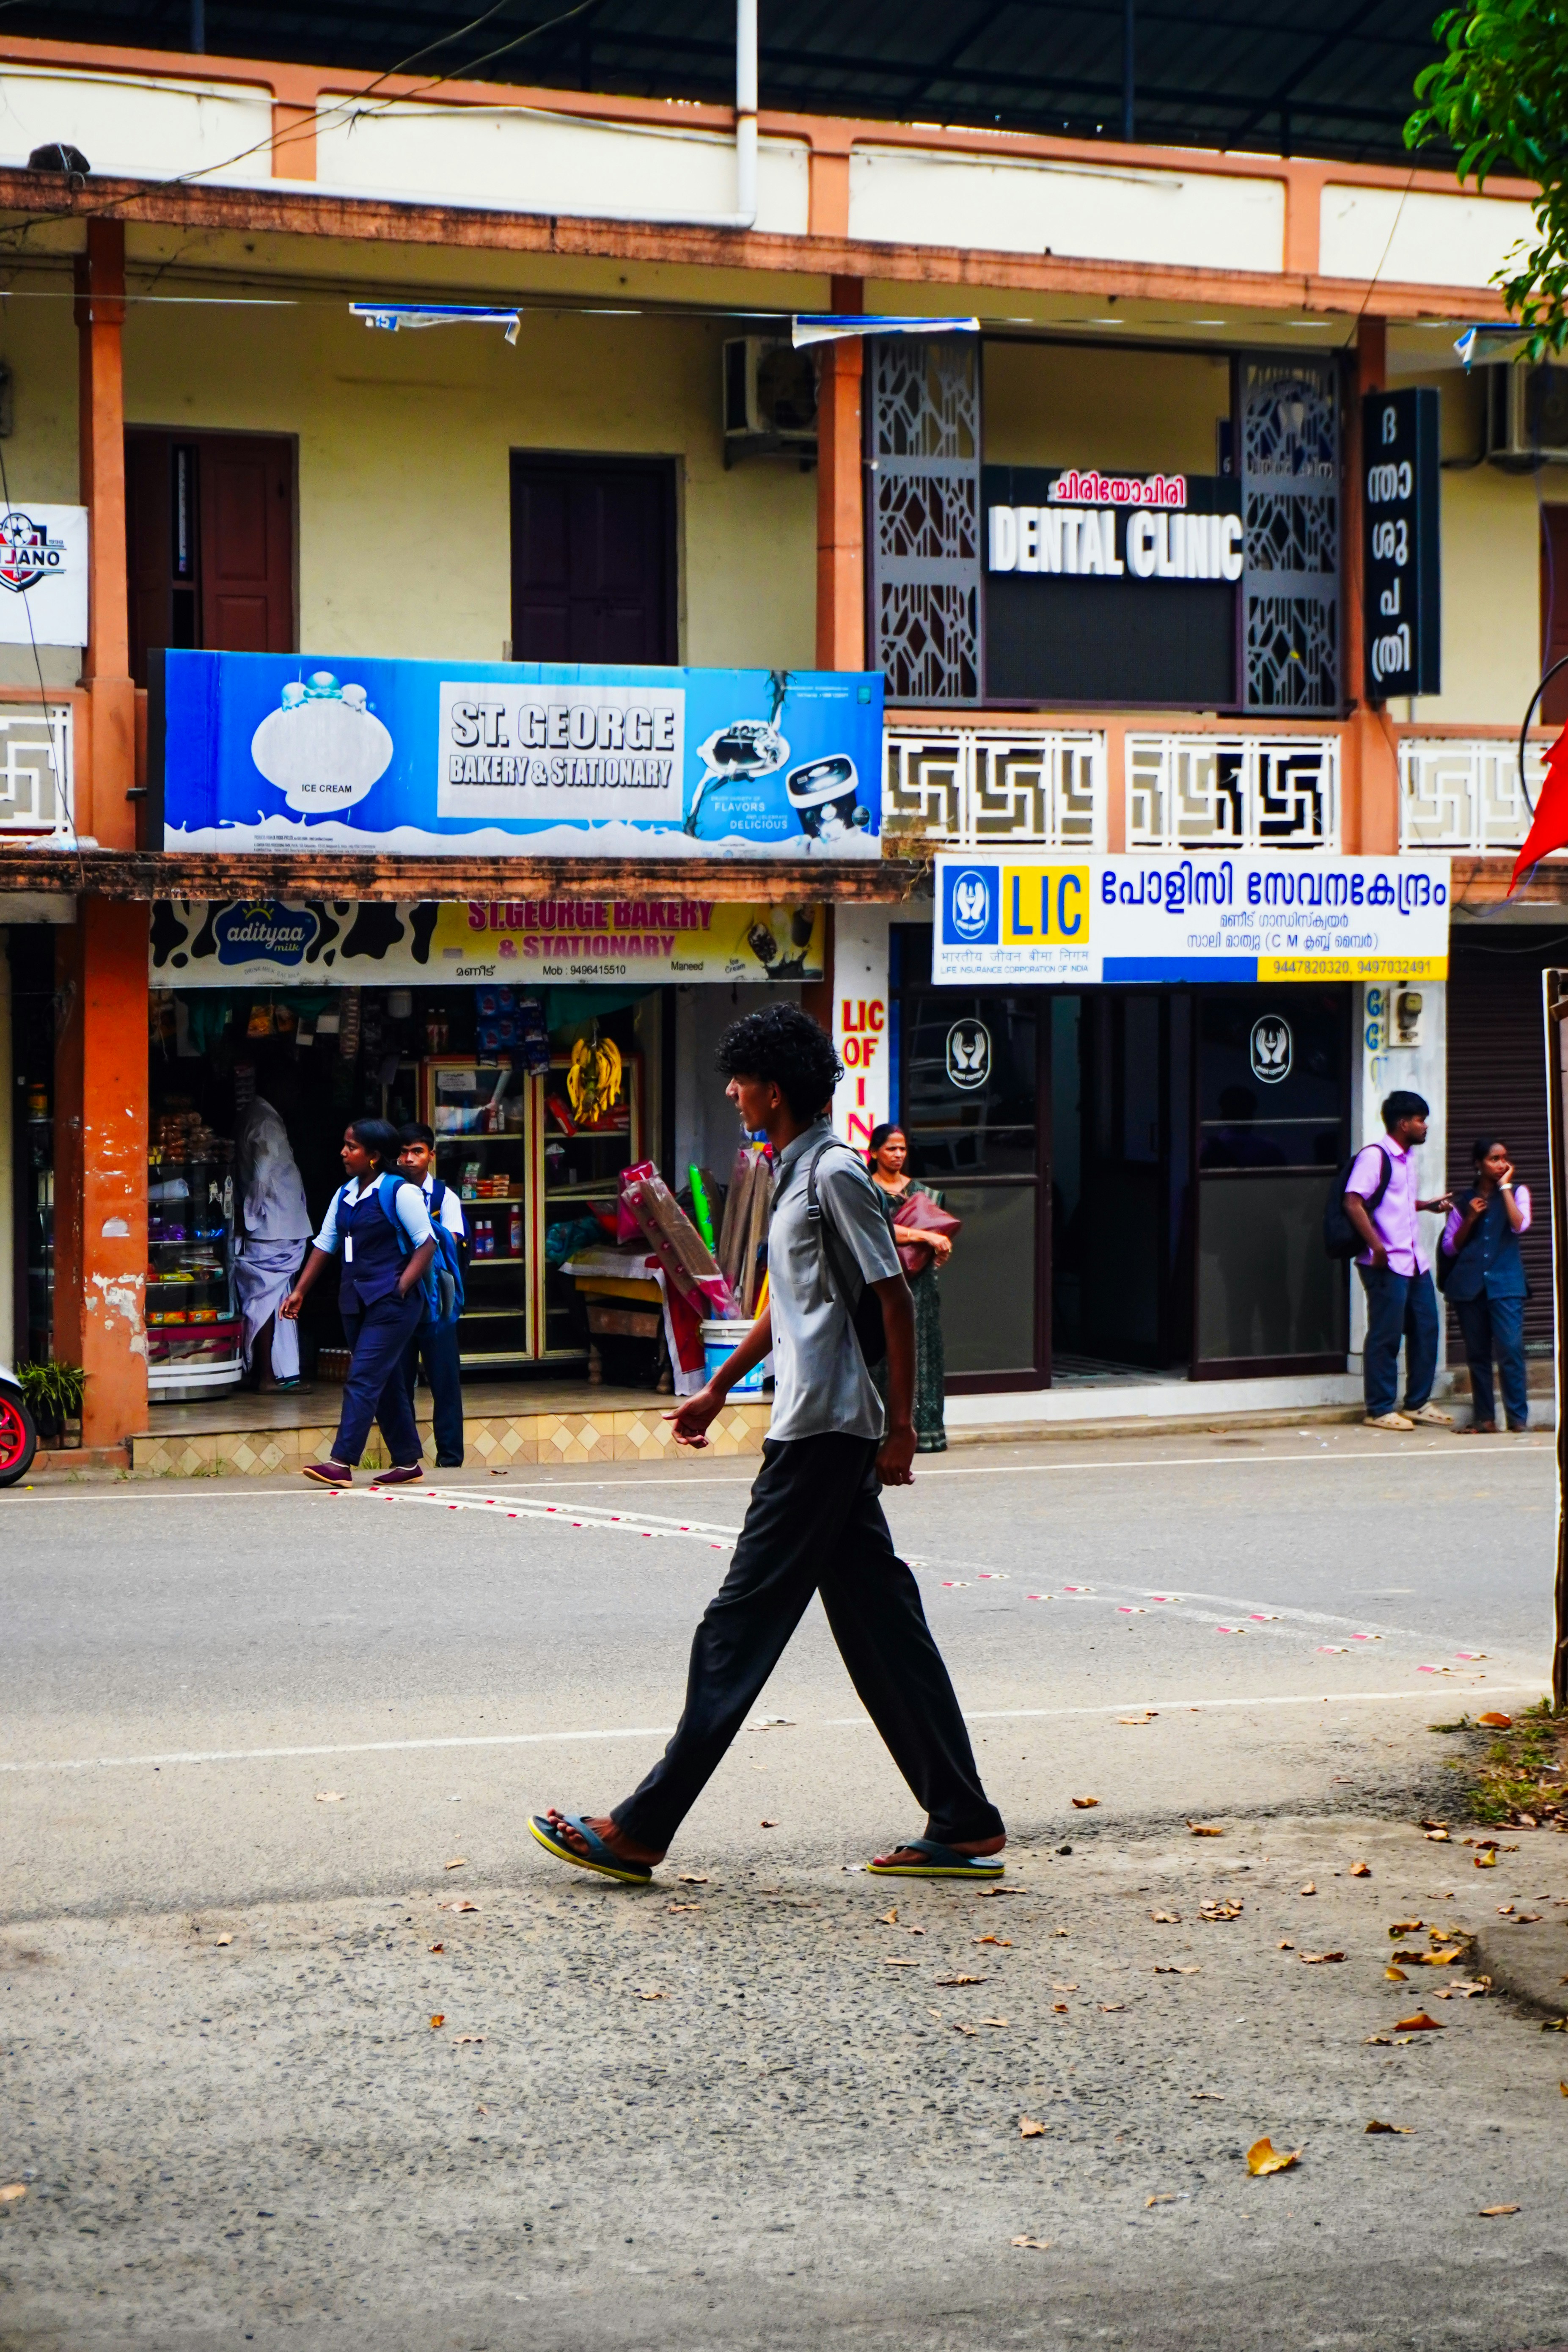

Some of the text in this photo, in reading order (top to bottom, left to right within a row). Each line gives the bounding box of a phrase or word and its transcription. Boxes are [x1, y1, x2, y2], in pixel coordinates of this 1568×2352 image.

[989, 506, 1243, 581] DENTAL CLINIC
[451, 702, 674, 751] ST. GEORGE
[449, 755, 671, 788] BAKERY & STATIONARY
[302, 784, 352, 793] ICE CREAM
[715, 802, 765, 812] FLAVORS
[730, 820, 788, 829] DELICIOUS
[1102, 861, 1446, 915] പോളിസി സേവനകേന്ദ്രം
[1012, 874, 1081, 935] LIC
[613, 902, 713, 931] BAKERY
[226, 921, 305, 950] adityaa
[1187, 931, 1221, 947] സാലി
[1226, 934, 1260, 951] മാത്യു
[1287, 935, 1298, 947] M
[274, 943, 300, 951] milk
[498, 935, 675, 959] & STATIONARY
[941, 948, 1089, 962] भारतीय जीवन बीमा निगम
[456, 965, 496, 976] മണീട്
[542, 966, 563, 975] Mob
[570, 965, 626, 974] 9496415510
[671, 961, 704, 971] Maneed
[1273, 960, 1431, 976] 9447820320, 9497032491
[842, 999, 884, 1033] LIC
[843, 1036, 879, 1068] OF
